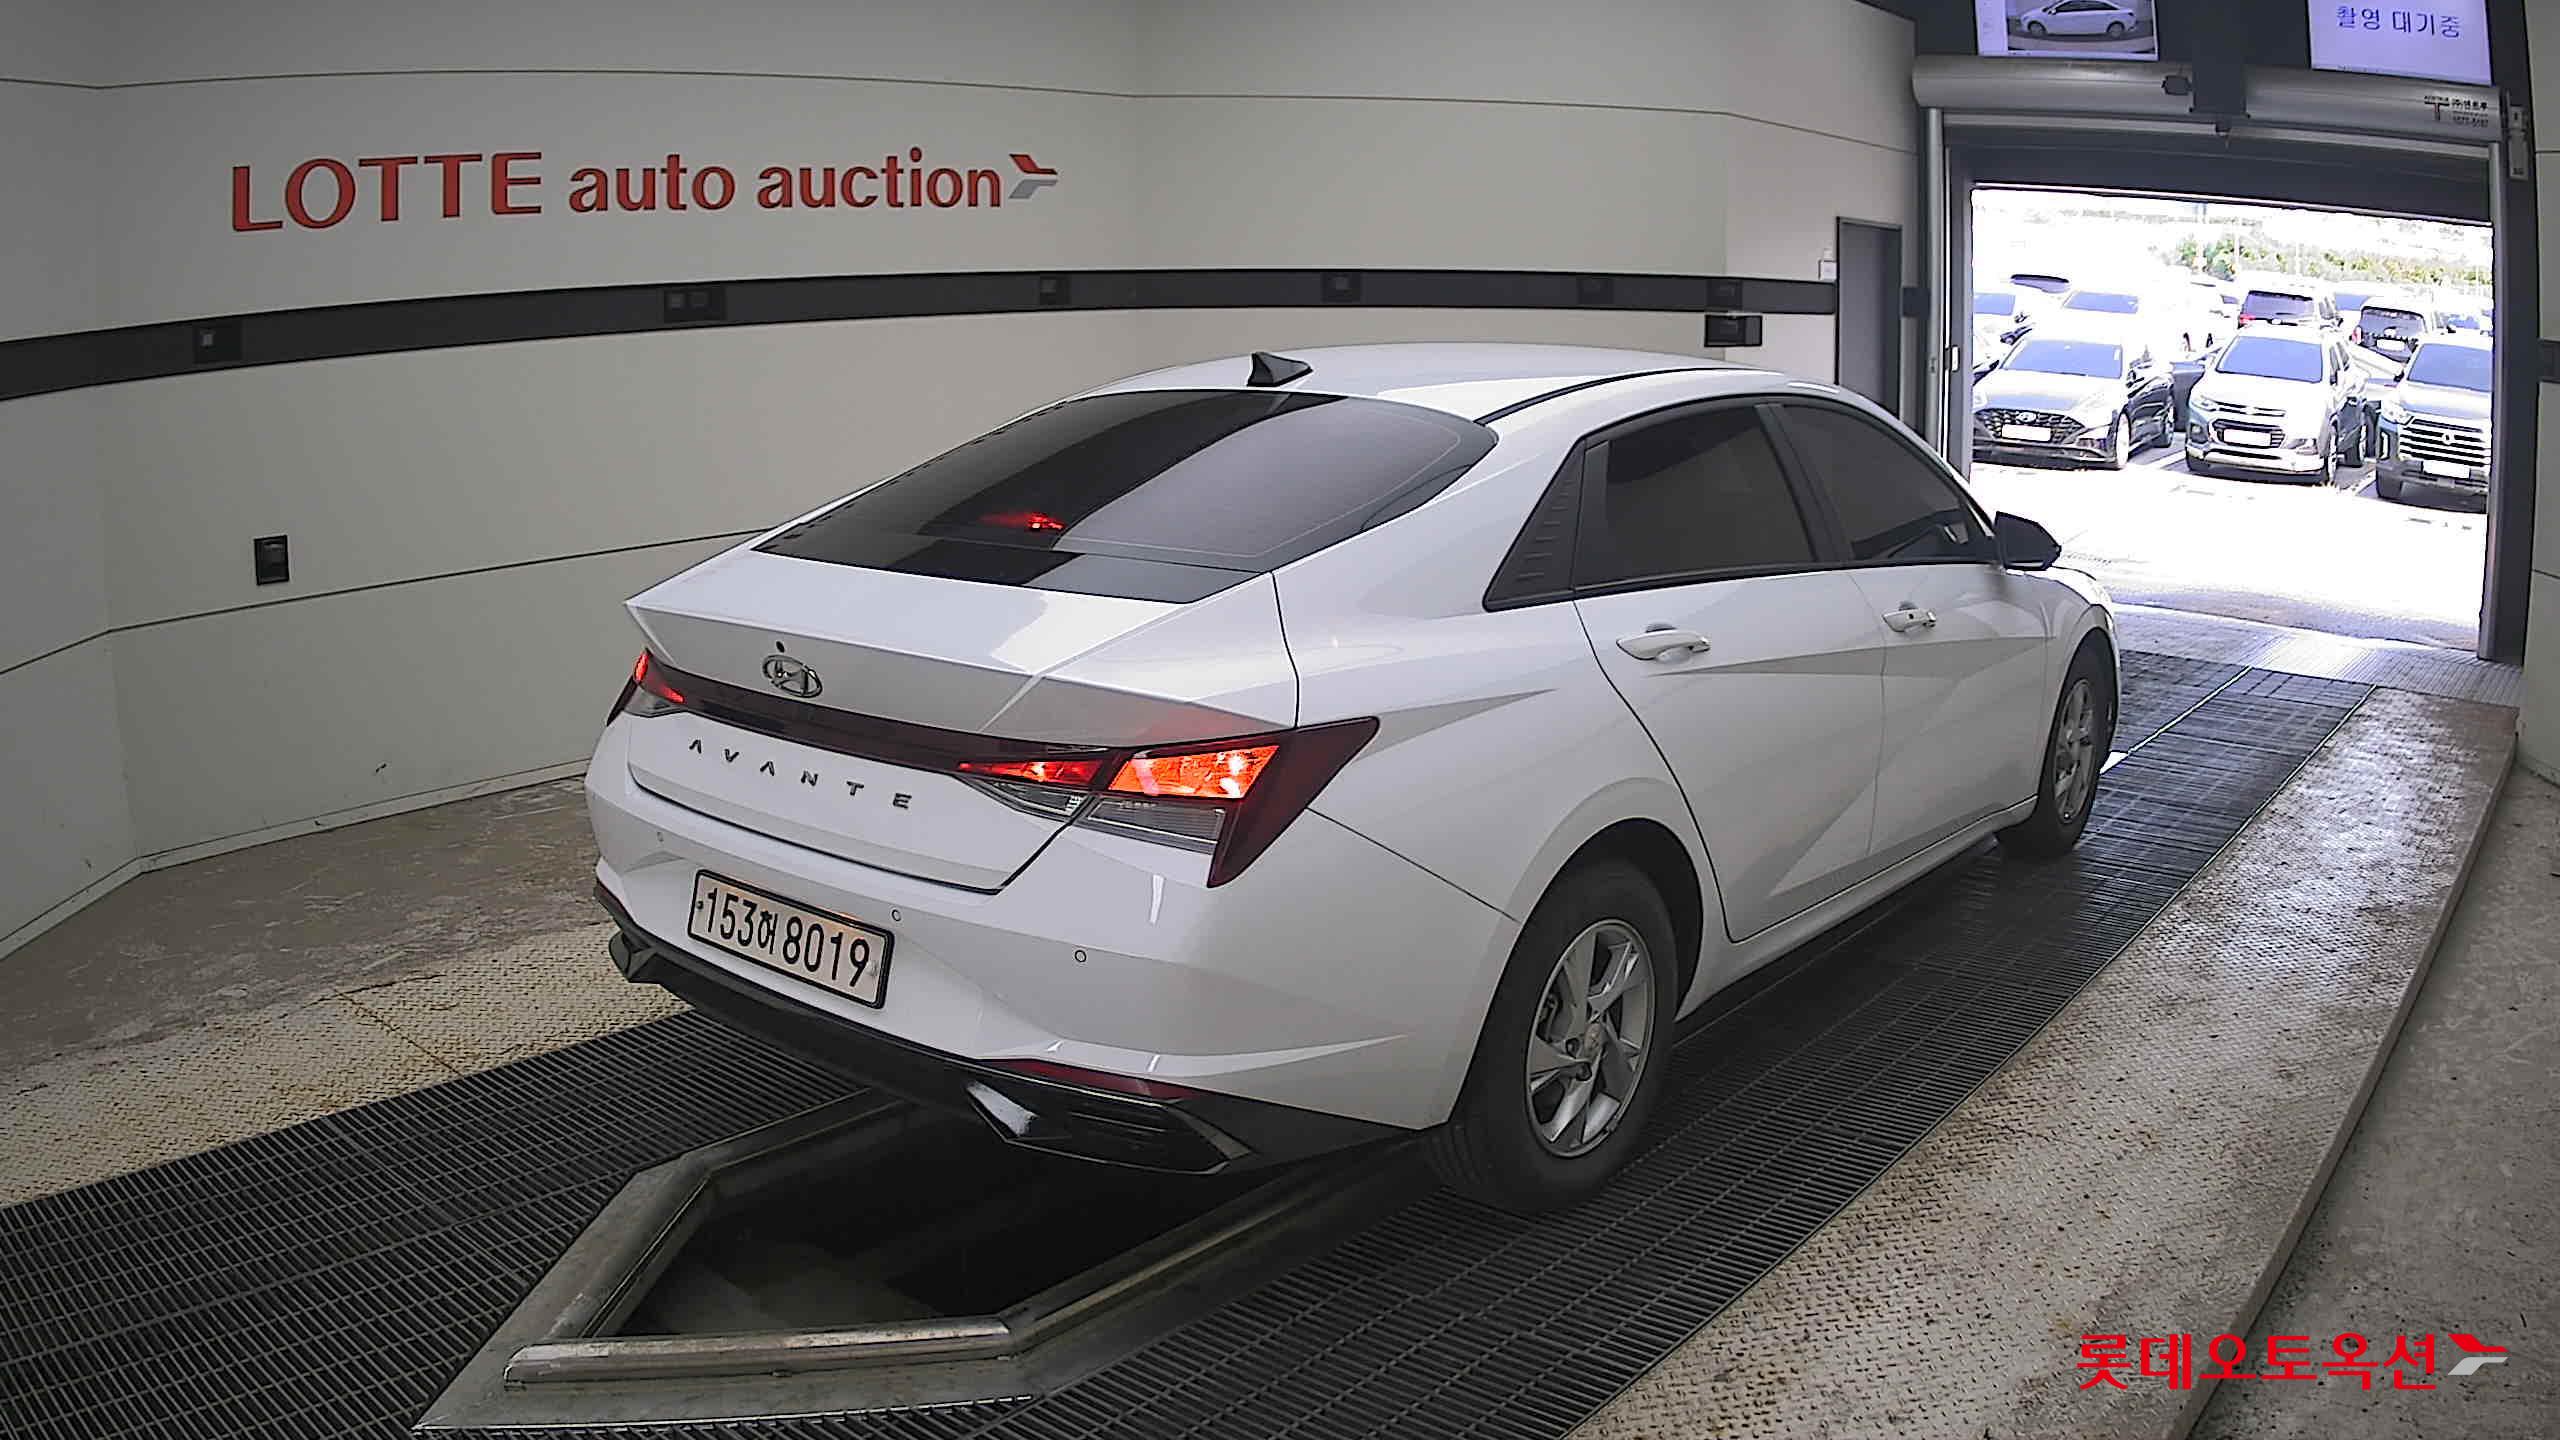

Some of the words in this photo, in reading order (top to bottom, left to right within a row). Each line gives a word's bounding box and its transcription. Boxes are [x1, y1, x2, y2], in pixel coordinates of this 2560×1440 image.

[2392, 11, 2461, 39] 대기중
[232, 151, 542, 232] LOTTE
[568, 153, 736, 213] auto
[756, 146, 1002, 210] auction
[689, 739, 912, 810] AVANTE
[707, 887, 870, 987] 153허8019
